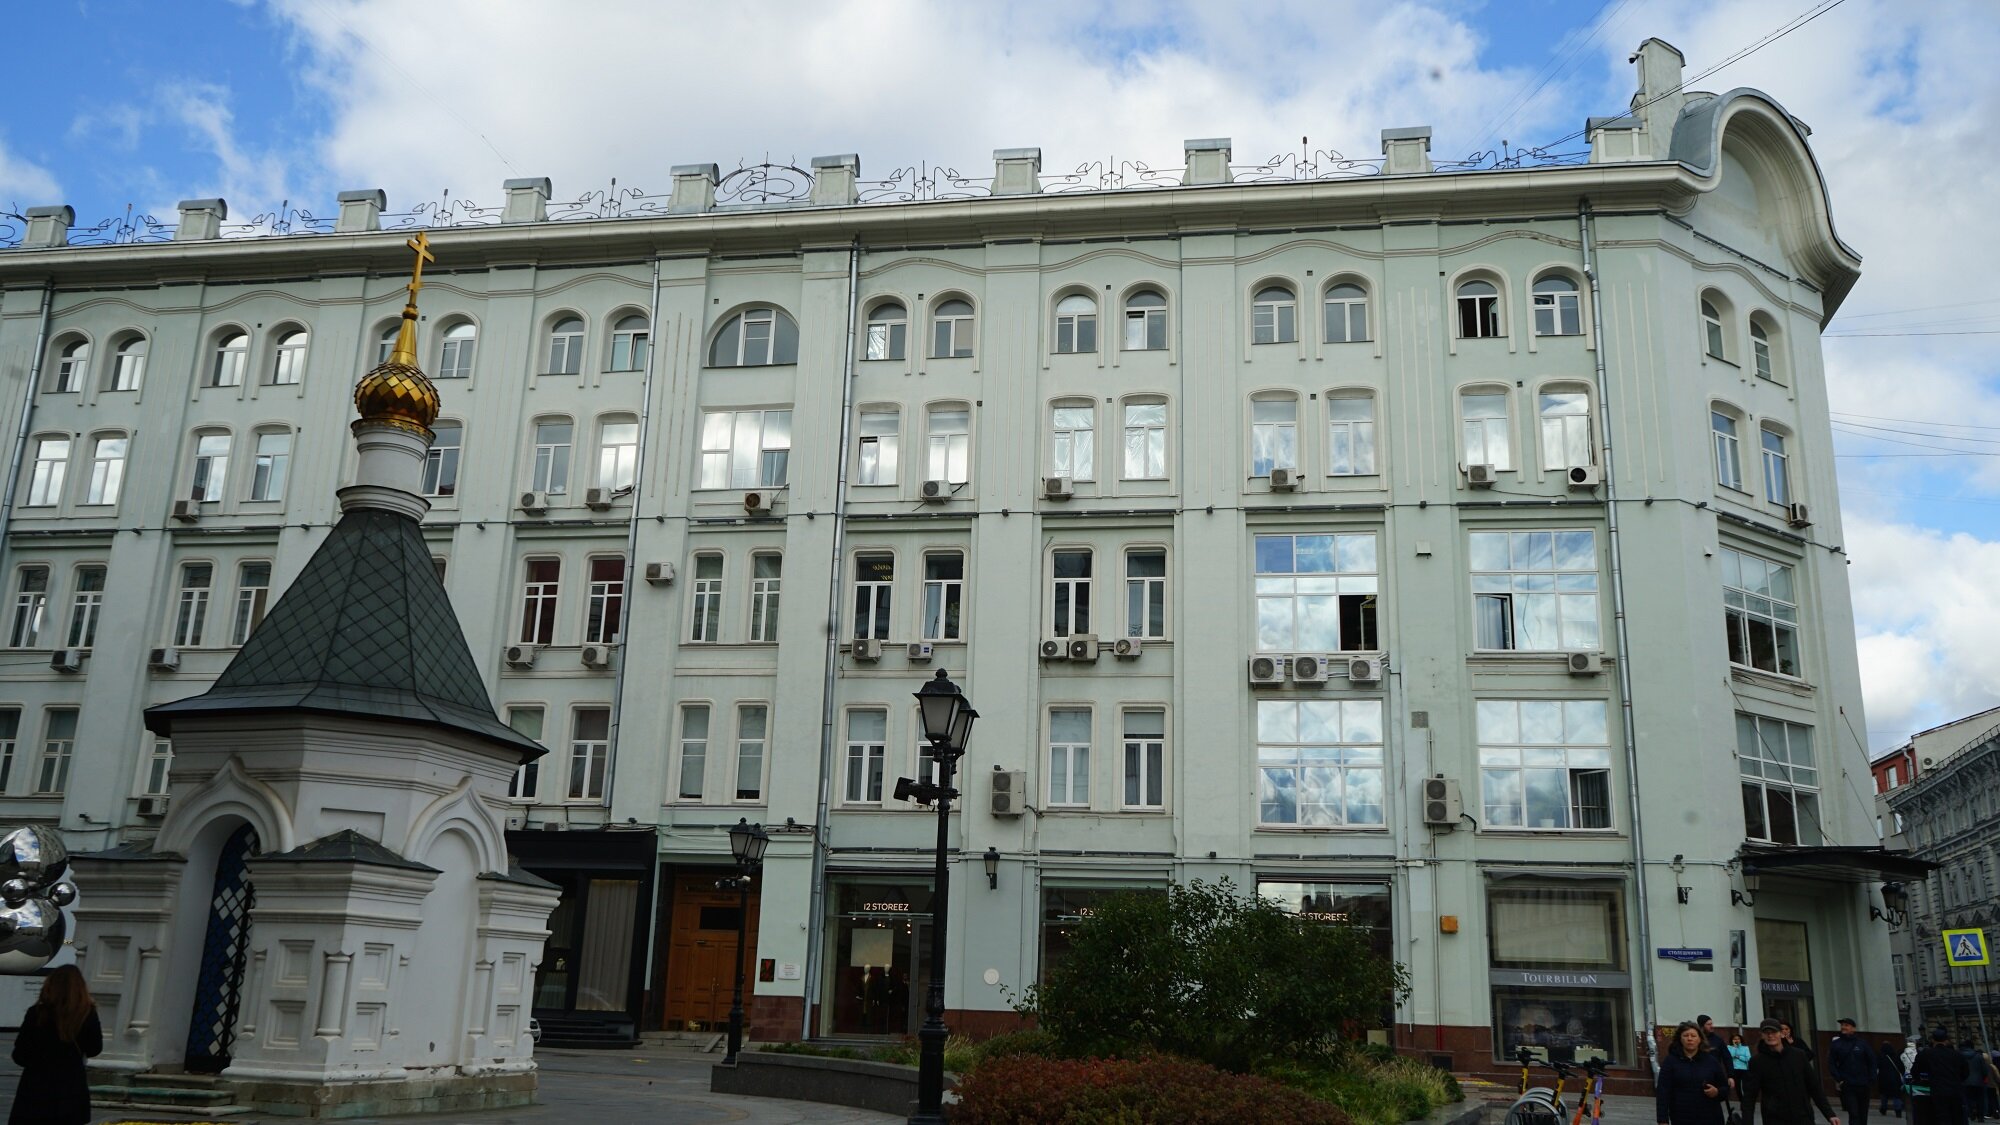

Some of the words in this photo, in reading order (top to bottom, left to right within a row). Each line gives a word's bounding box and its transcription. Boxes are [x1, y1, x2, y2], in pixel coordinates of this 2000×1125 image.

[863, 902, 871, 911] 12
[872, 902, 909, 912] STOREEZ
[1080, 907, 1088, 916] 12
[1521, 972, 1598, 985] TOURBILLON
